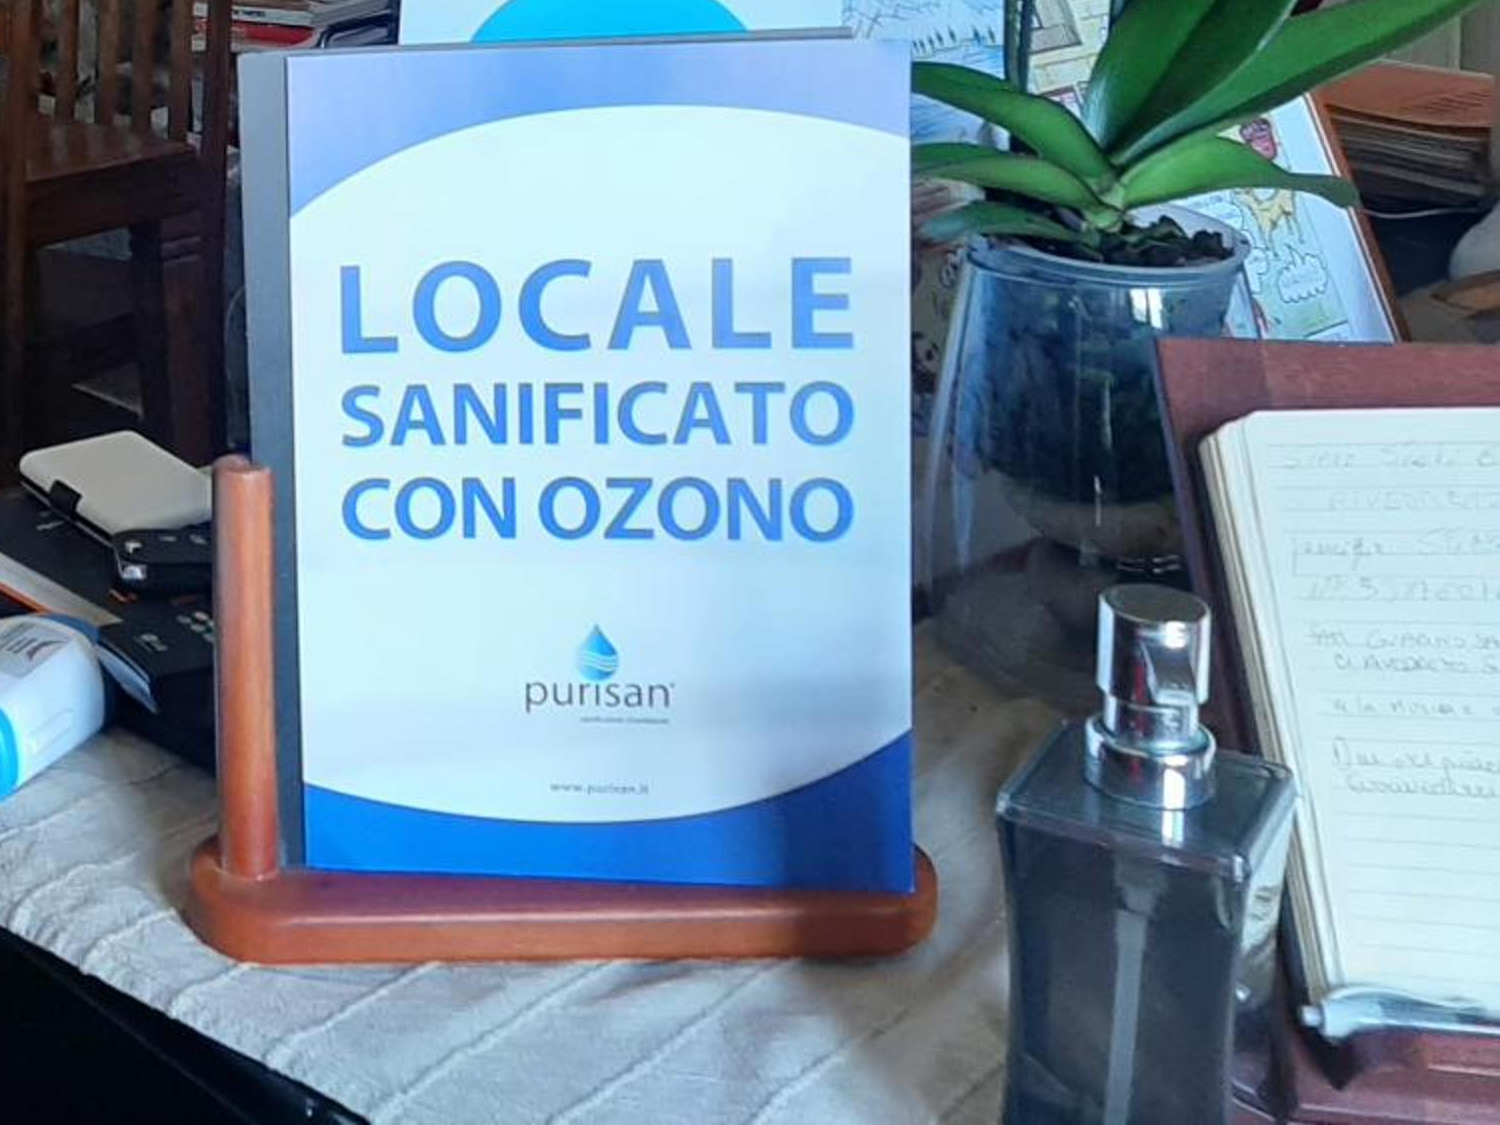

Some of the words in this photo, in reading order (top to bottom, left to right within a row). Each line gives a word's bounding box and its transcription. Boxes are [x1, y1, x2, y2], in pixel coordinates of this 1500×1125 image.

[340, 256, 856, 356] LOCALE
[340, 380, 857, 449] SANIFICATO
[341, 476, 518, 542] CON
[537, 475, 857, 545] OZONO
[524, 679, 671, 714] purisan
